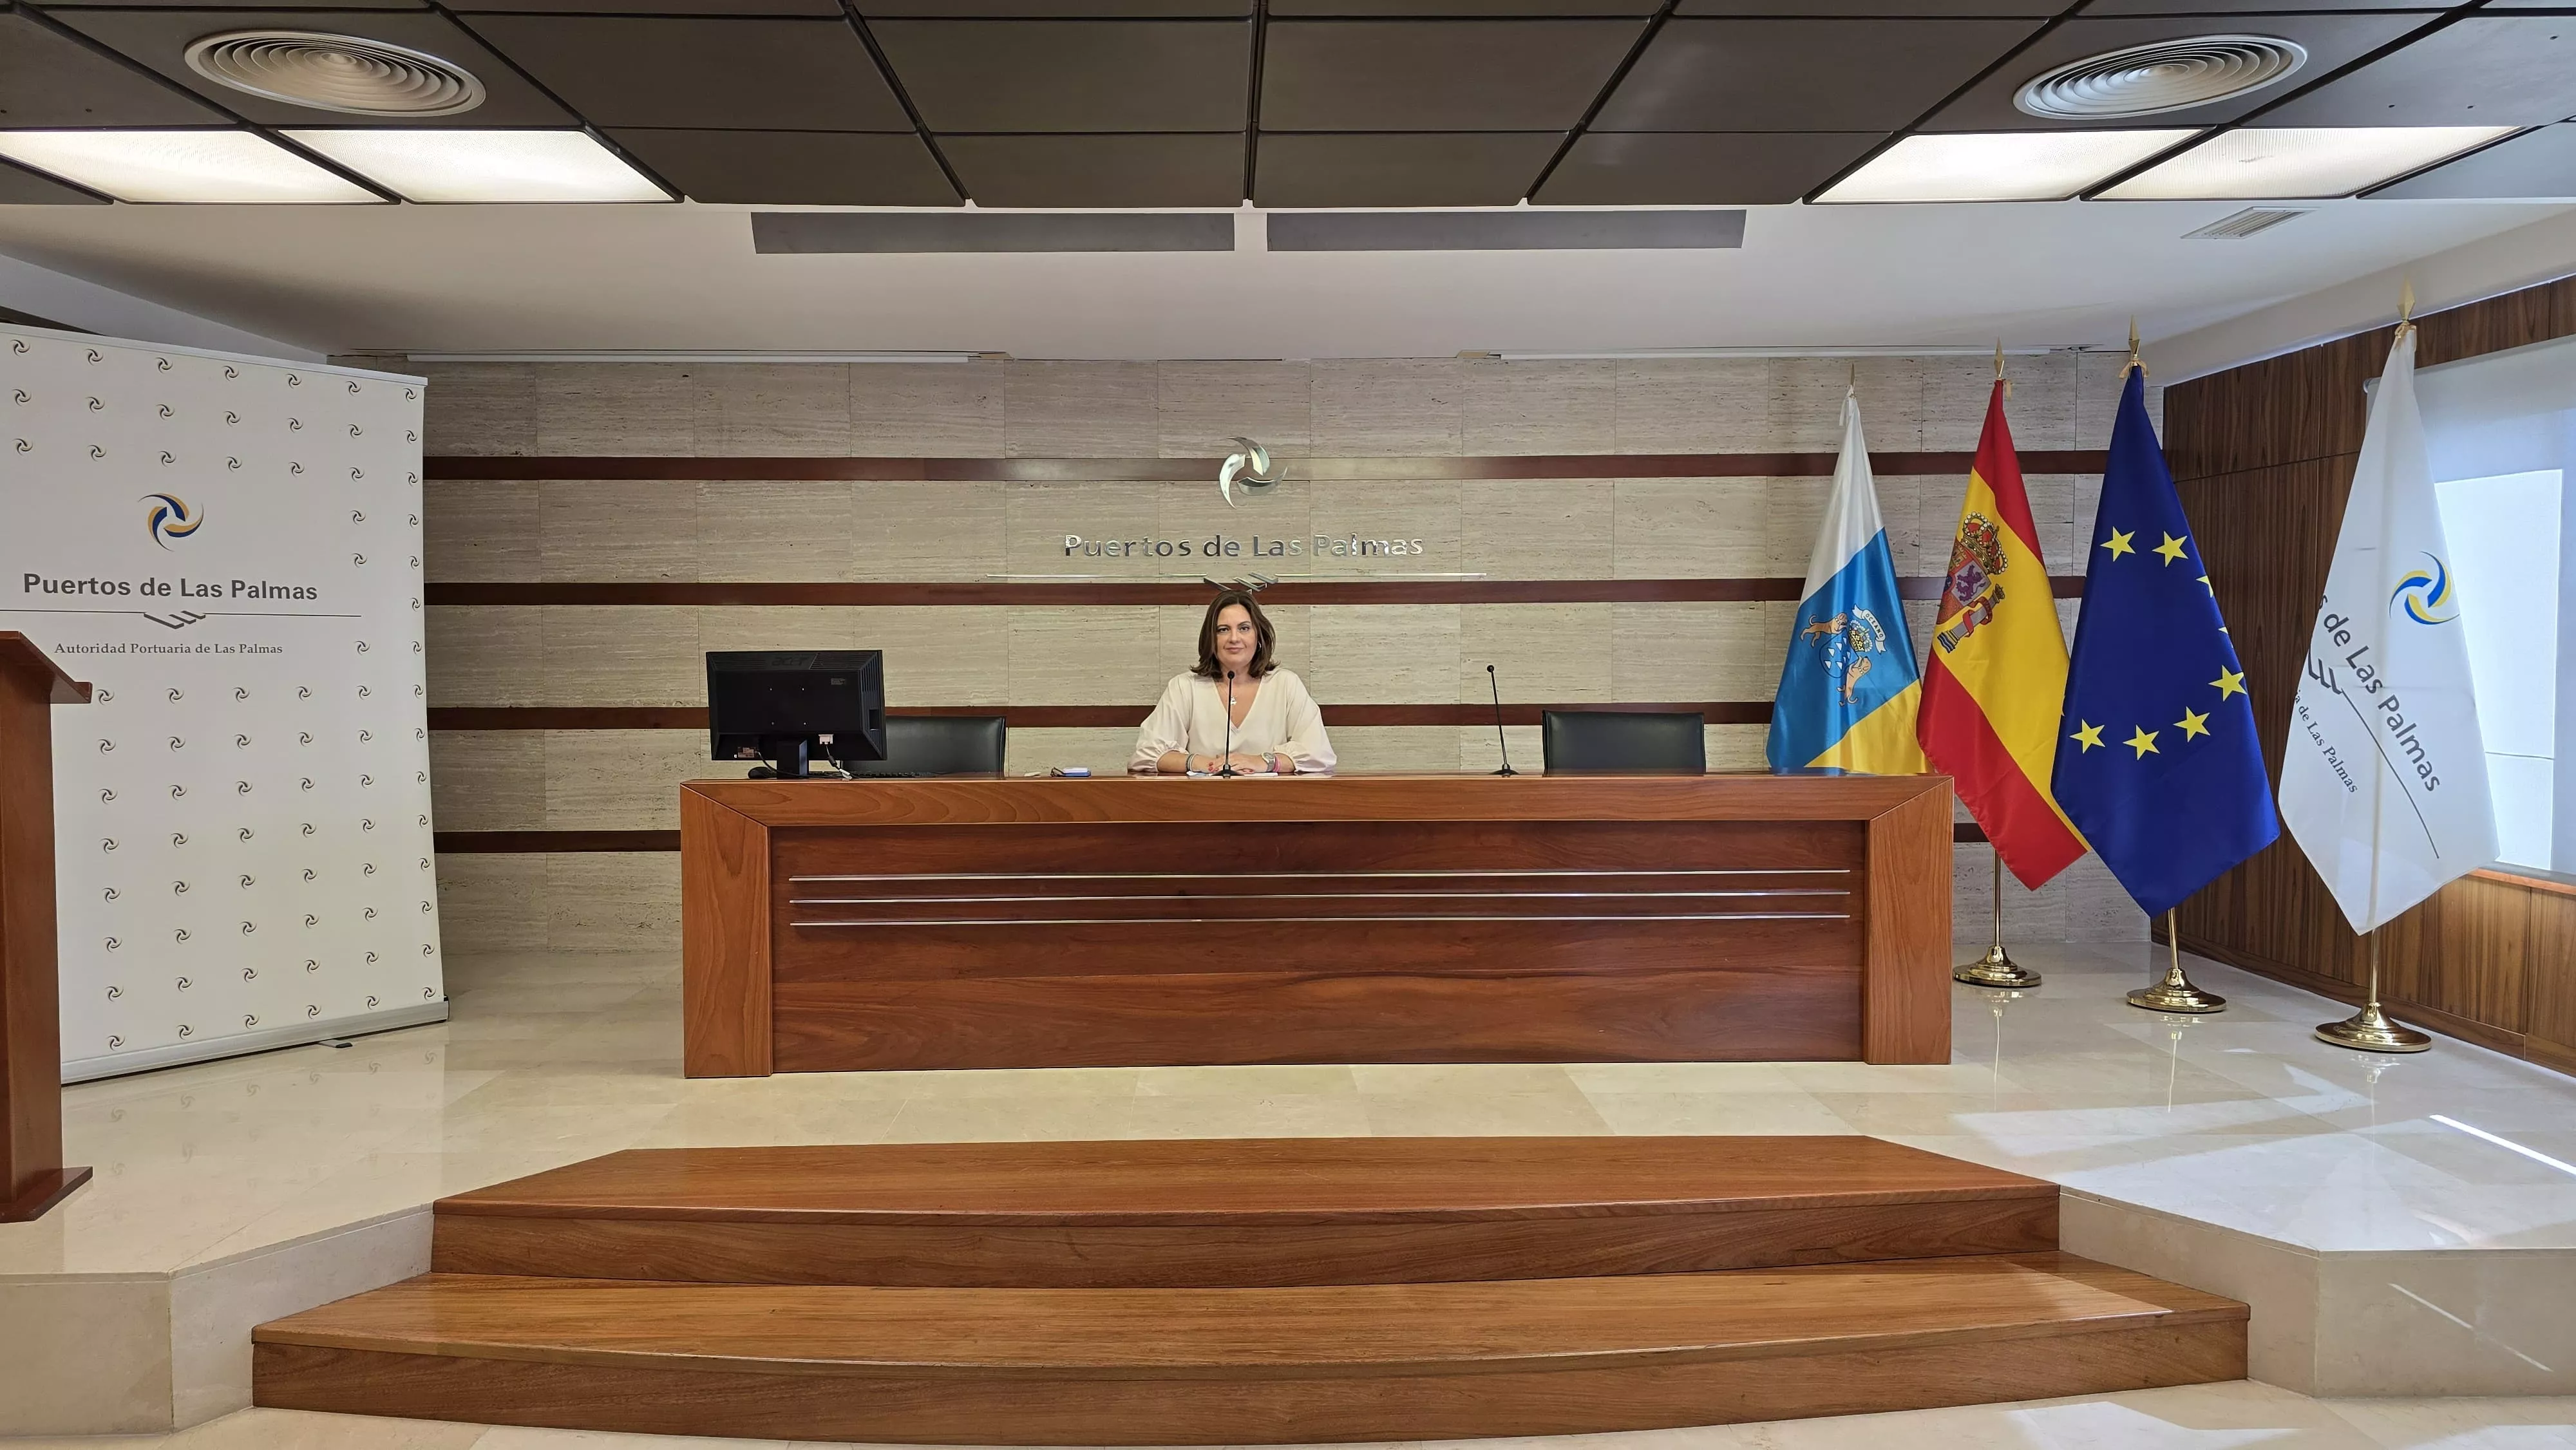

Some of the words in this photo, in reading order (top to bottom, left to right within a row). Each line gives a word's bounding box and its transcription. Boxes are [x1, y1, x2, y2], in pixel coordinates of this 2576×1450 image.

[1065, 534, 1192, 557] Puertos
[1202, 534, 1241, 557] de
[1253, 534, 1303, 557] Las
[1313, 532, 1423, 557] Palmas
[24, 573, 131, 596] Puertos
[140, 577, 171, 597] de
[180, 578, 223, 598] Las
[231, 579, 317, 600] Palmas
[1865, 613, 1884, 637] OCEANO
[54, 643, 126, 654] Autoridad
[130, 643, 191, 654] Portuaria
[195, 643, 211, 654] de
[214, 643, 236, 654] Las
[239, 643, 283, 654] Palmas
[2324, 614, 2351, 647] de
[2345, 645, 2383, 694] Las
[2378, 694, 2440, 791] Palmas
[2298, 706, 2310, 722] de
[2307, 720, 2325, 746] Las
[2322, 745, 2358, 793] Palmas
